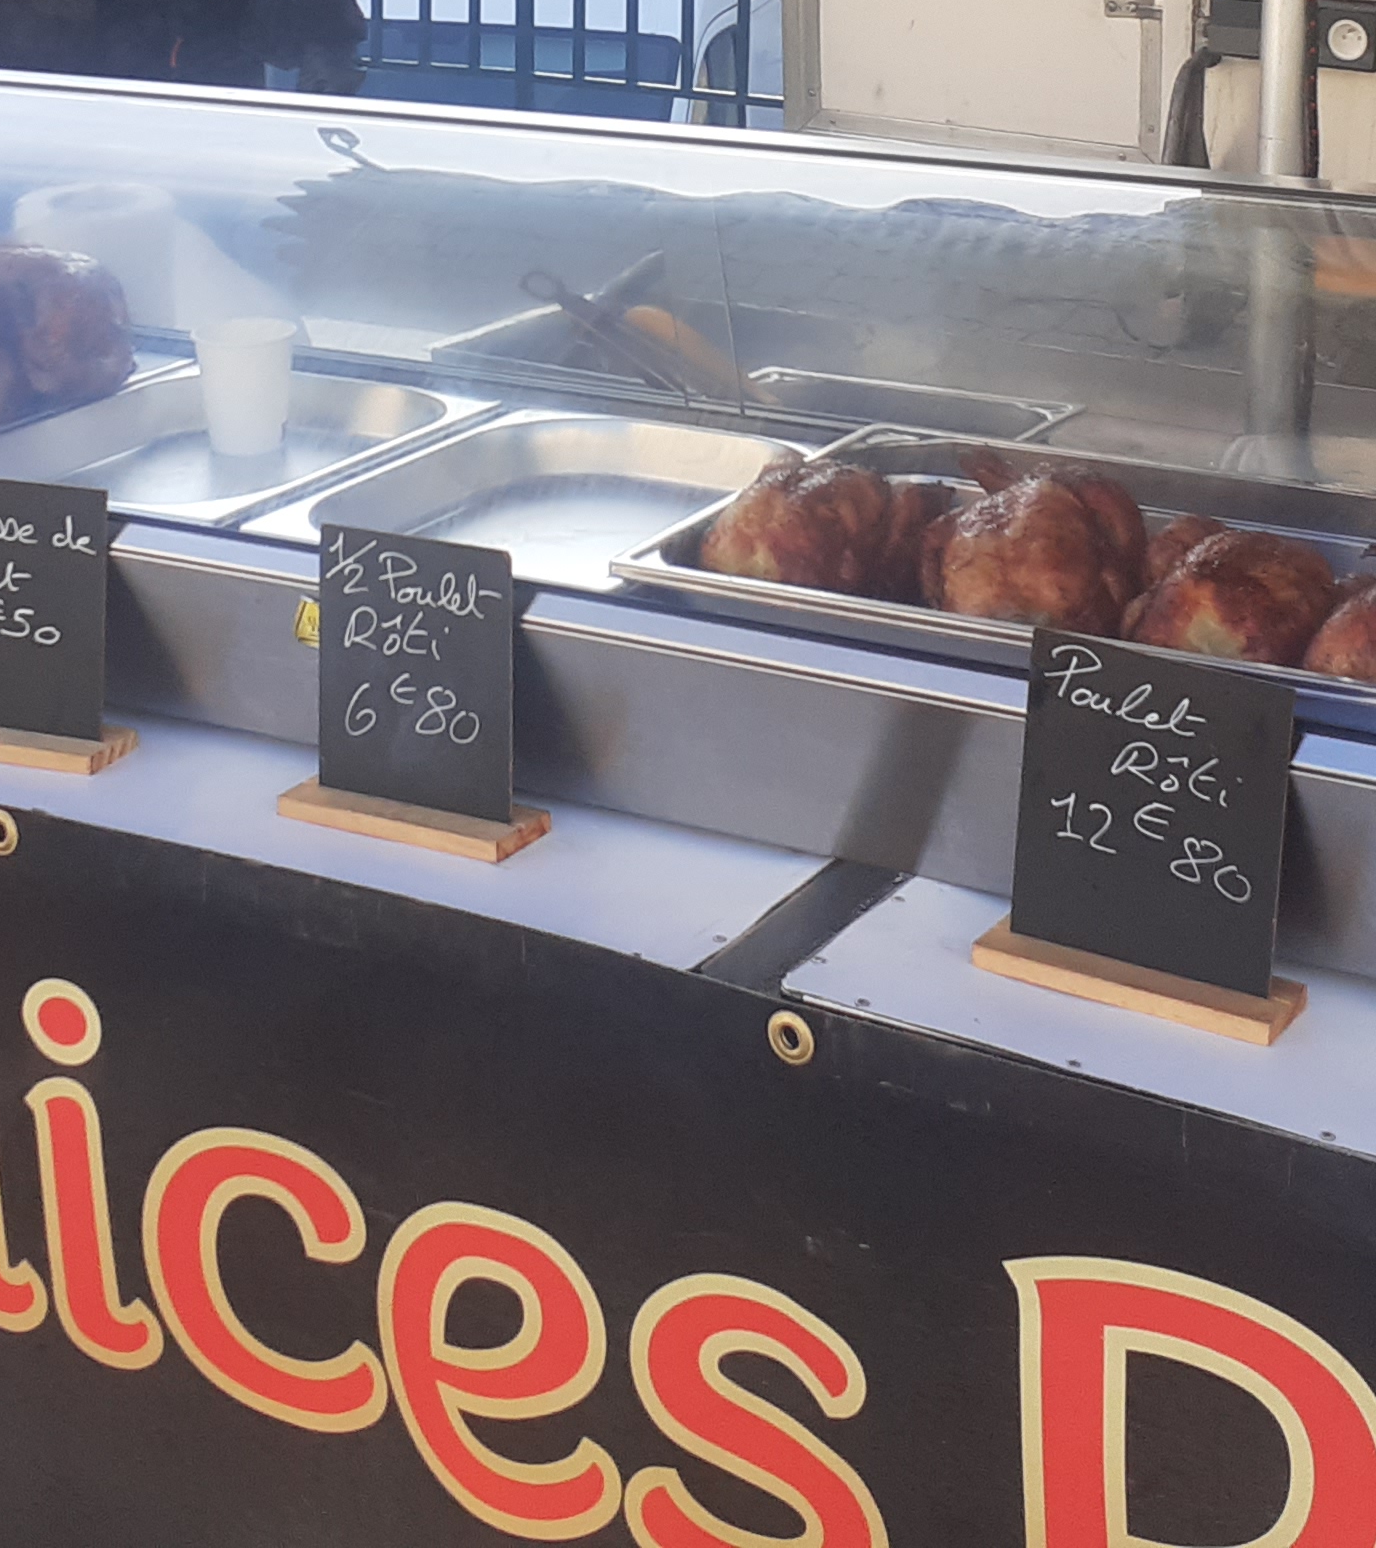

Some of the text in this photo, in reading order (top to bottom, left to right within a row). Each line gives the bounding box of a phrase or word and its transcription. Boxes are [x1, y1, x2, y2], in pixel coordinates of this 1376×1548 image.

[52, 515, 97, 556] de
[378, 552, 502, 620] Poulet
[344, 606, 449, 661] Rôti
[1044, 644, 1207, 737] Poulet
[1111, 742, 1242, 807] Rôti
